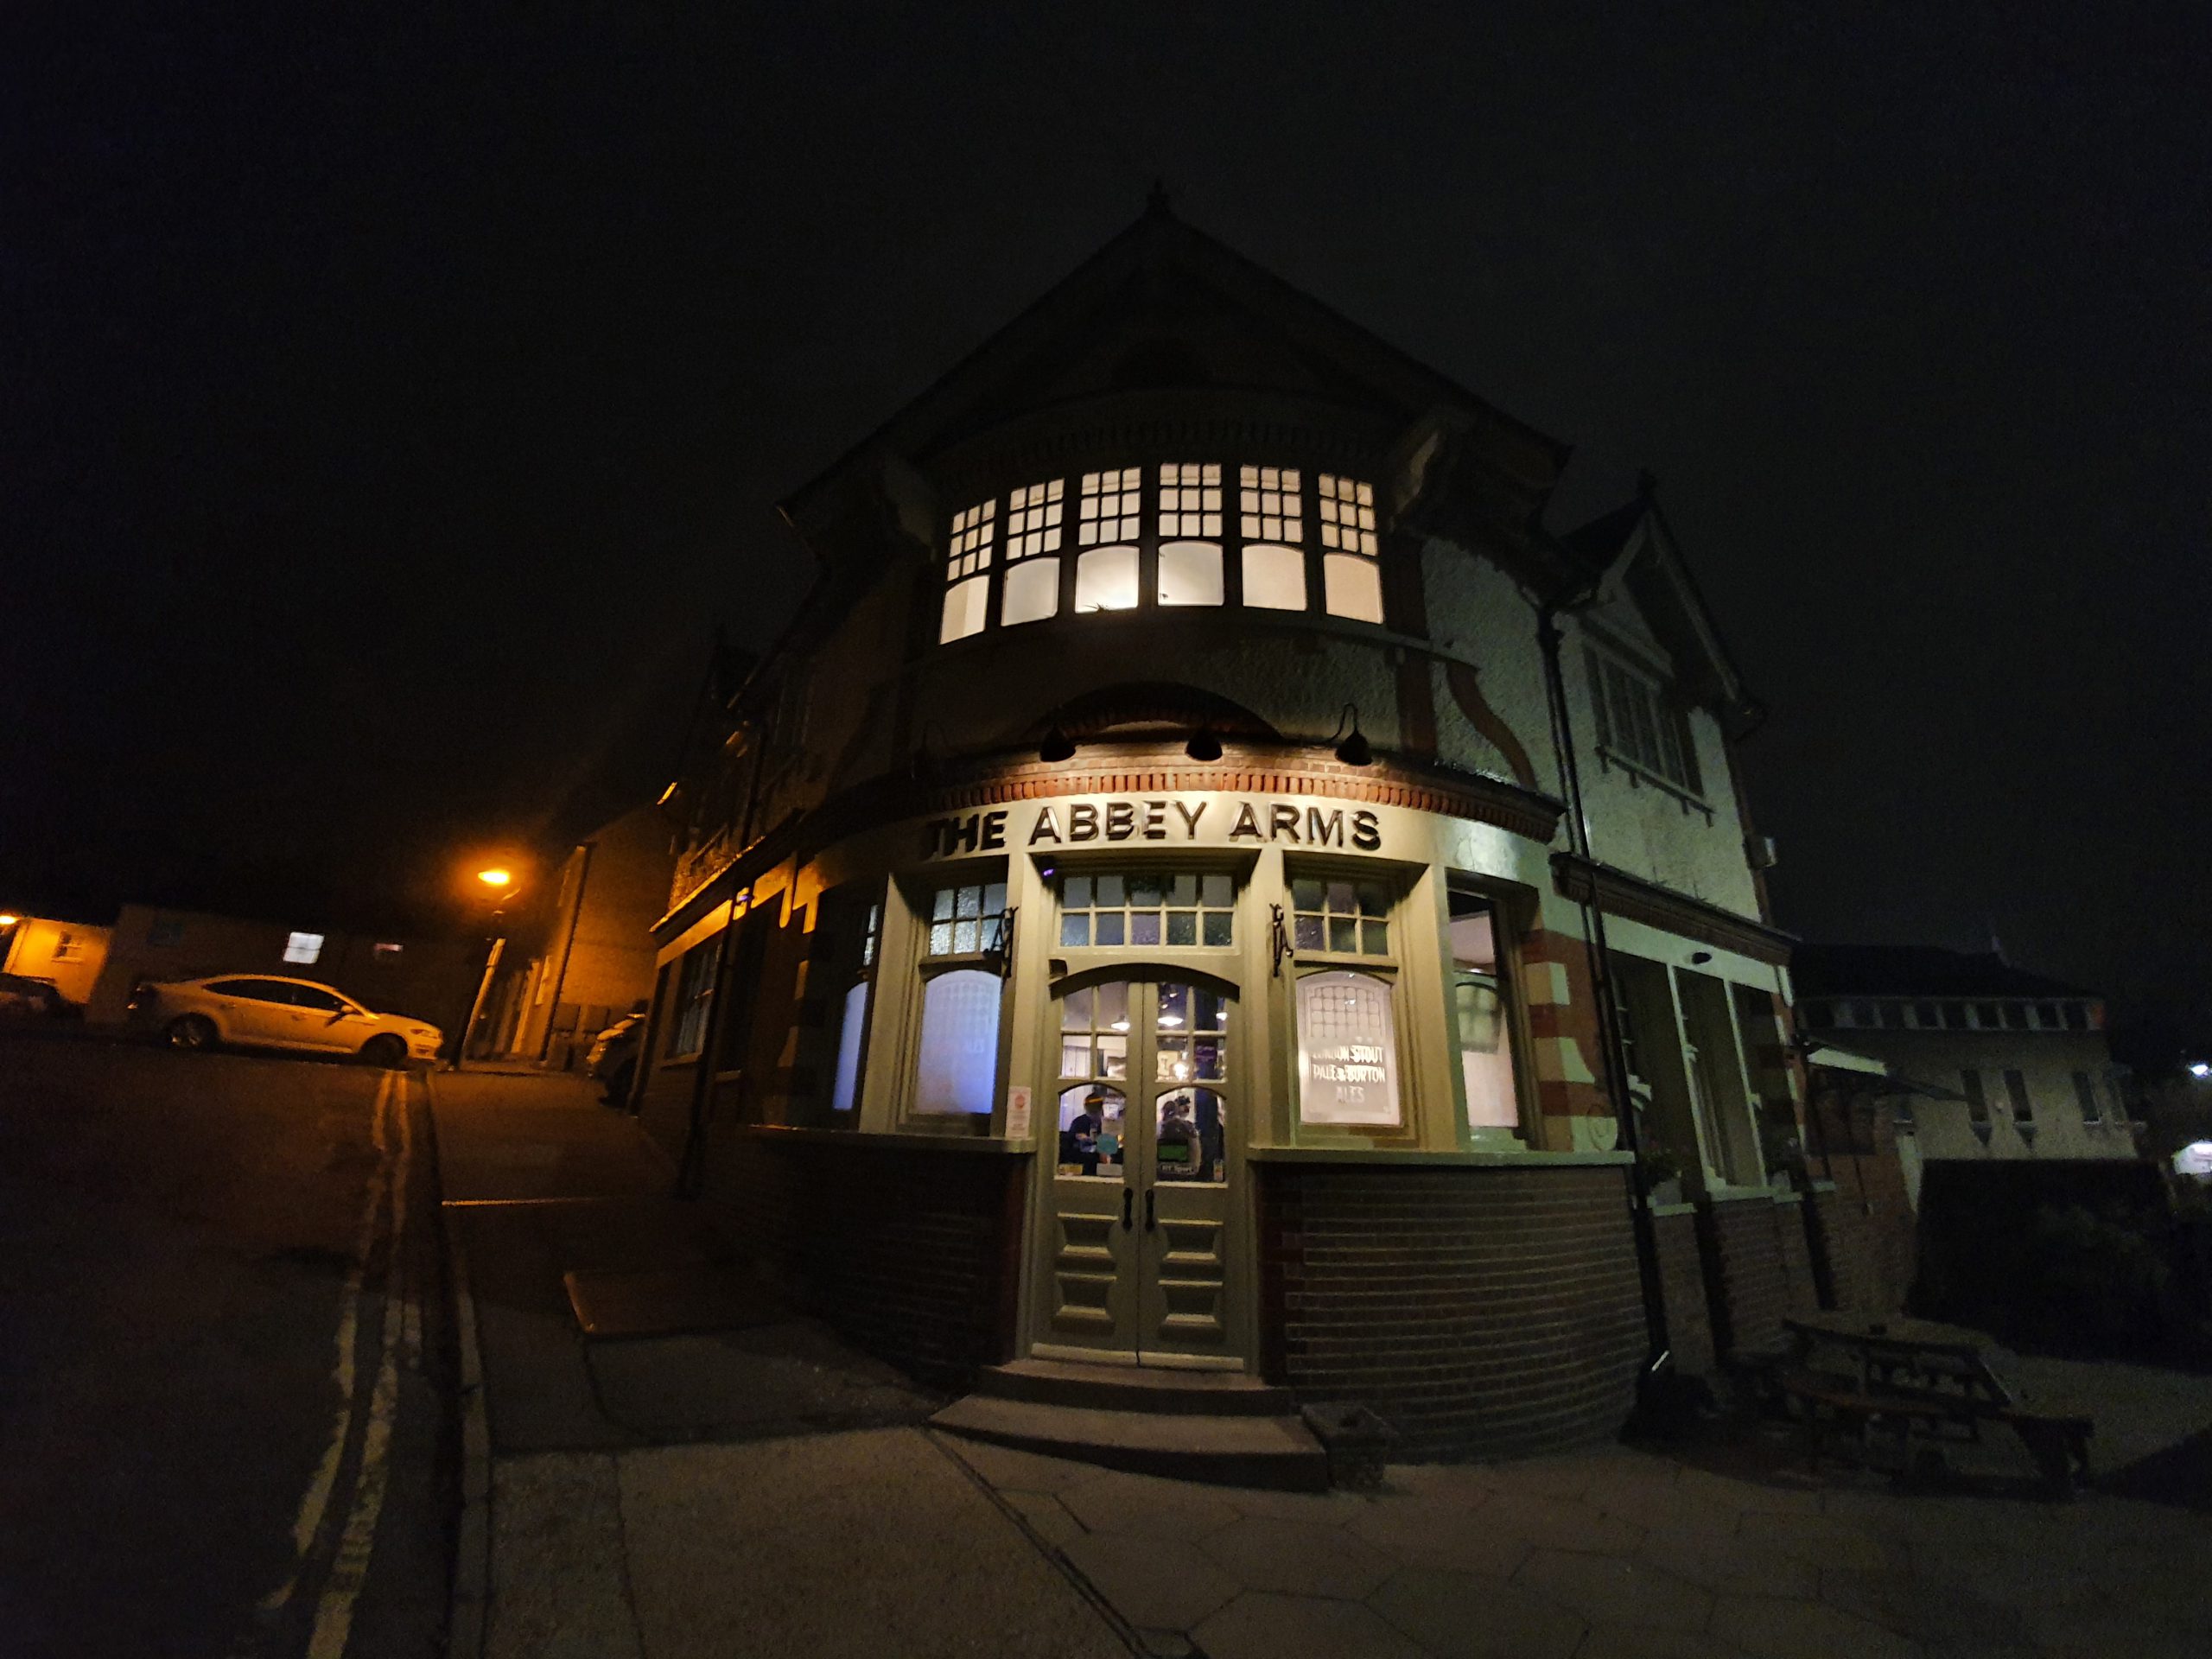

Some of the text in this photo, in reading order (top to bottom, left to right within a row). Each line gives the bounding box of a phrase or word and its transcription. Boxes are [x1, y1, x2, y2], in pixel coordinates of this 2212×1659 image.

[922, 800, 1382, 861] THE ABBEY ARMS
[1350, 1045, 1383, 1063] STOUT
[1312, 1064, 1386, 1083] PALE & BURTON
[1336, 1085, 1365, 1103] ALES
